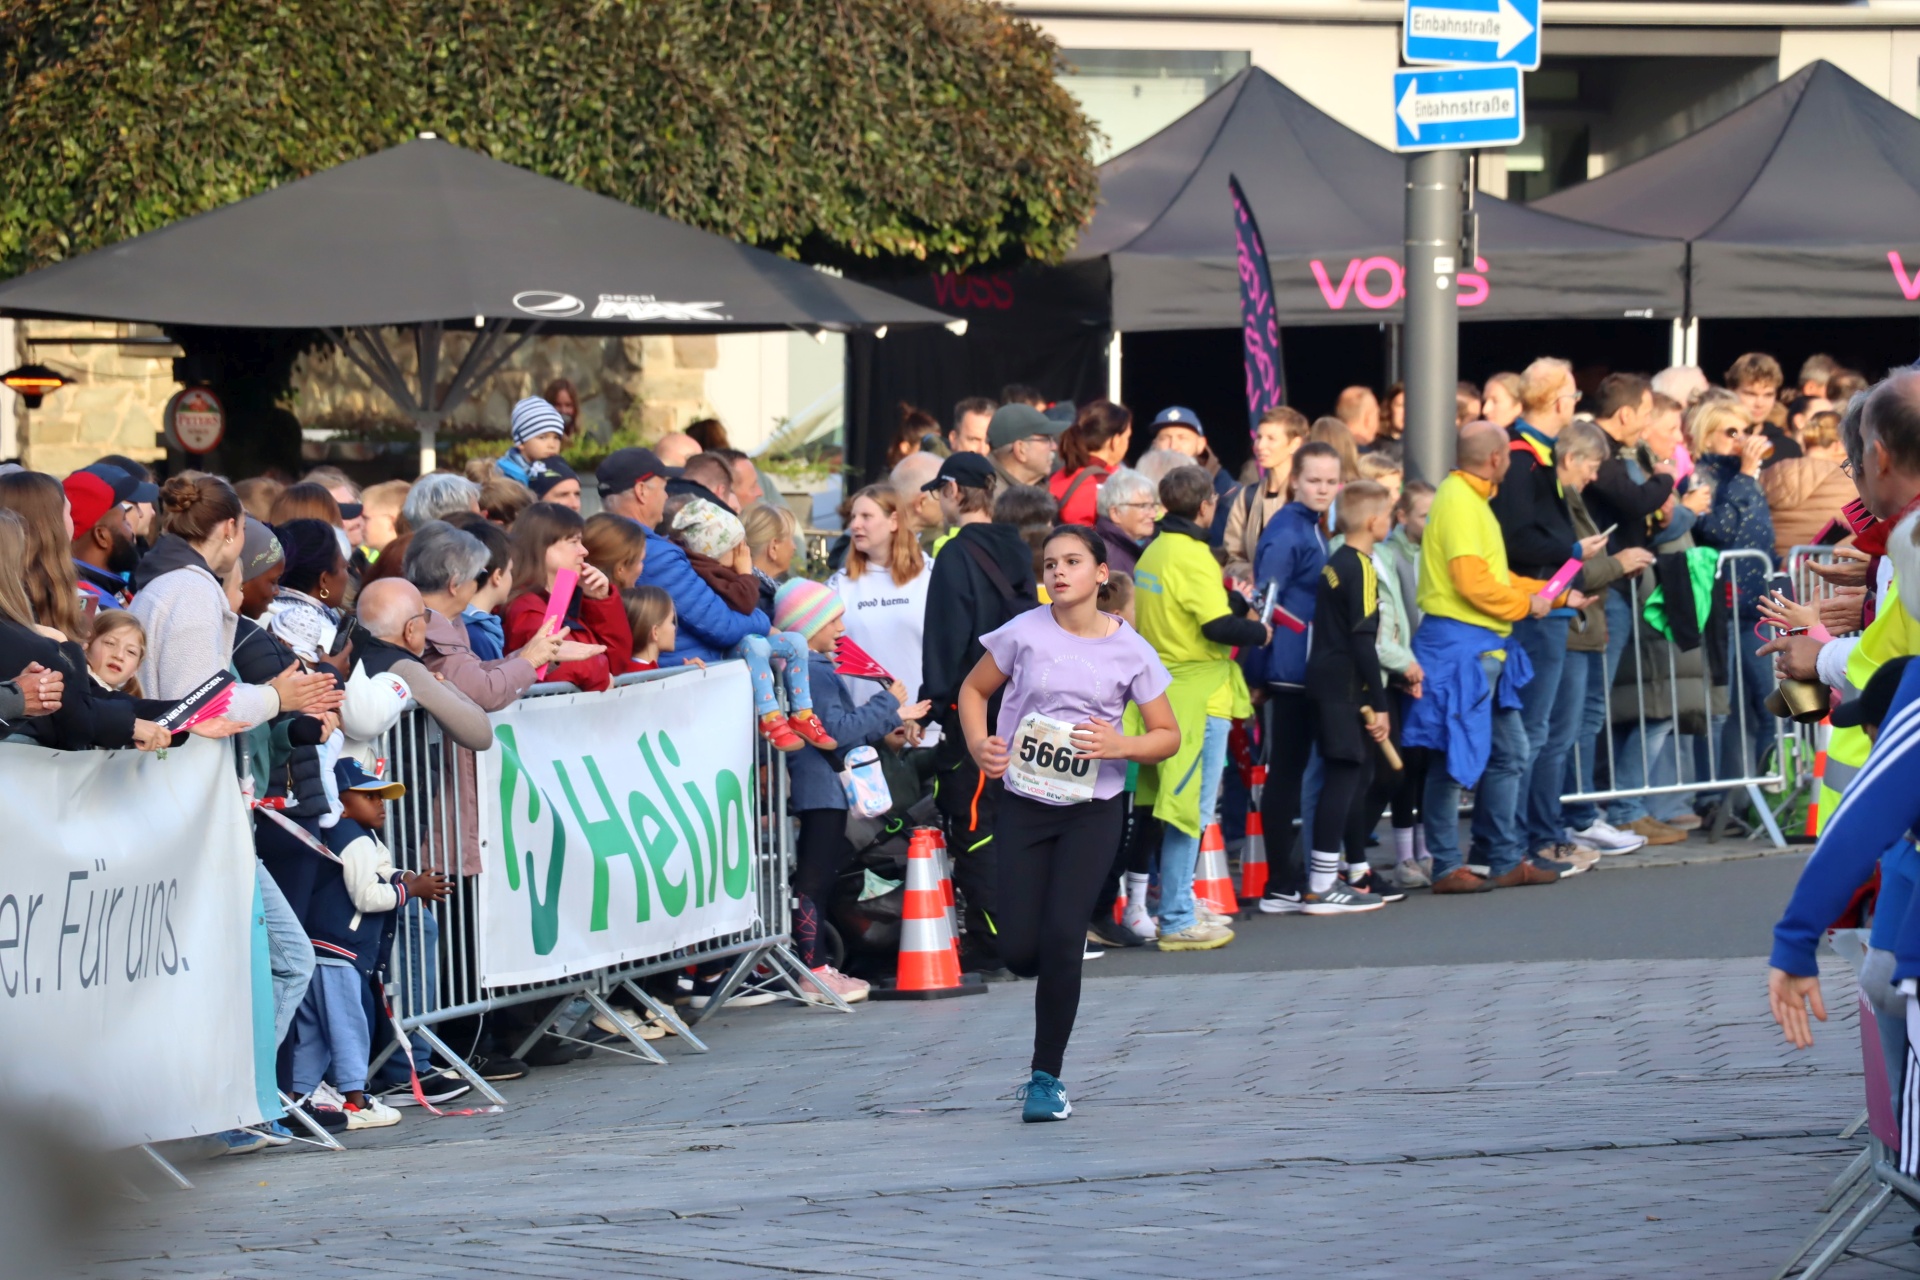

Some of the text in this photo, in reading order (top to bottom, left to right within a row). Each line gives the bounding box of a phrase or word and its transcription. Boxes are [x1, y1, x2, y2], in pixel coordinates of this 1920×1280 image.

[1413, 13, 1501, 36] Einbahnstraße
[1309, 255, 1490, 310] VOS
[857, 597, 878, 610] good
[165, 702, 188, 722] NEUE
[185, 675, 225, 706] CHANCEN.
[1020, 734, 1091, 778] 5660
[551, 729, 756, 933] Helio
[57, 858, 124, 989] Für
[126, 878, 190, 983] uns.
